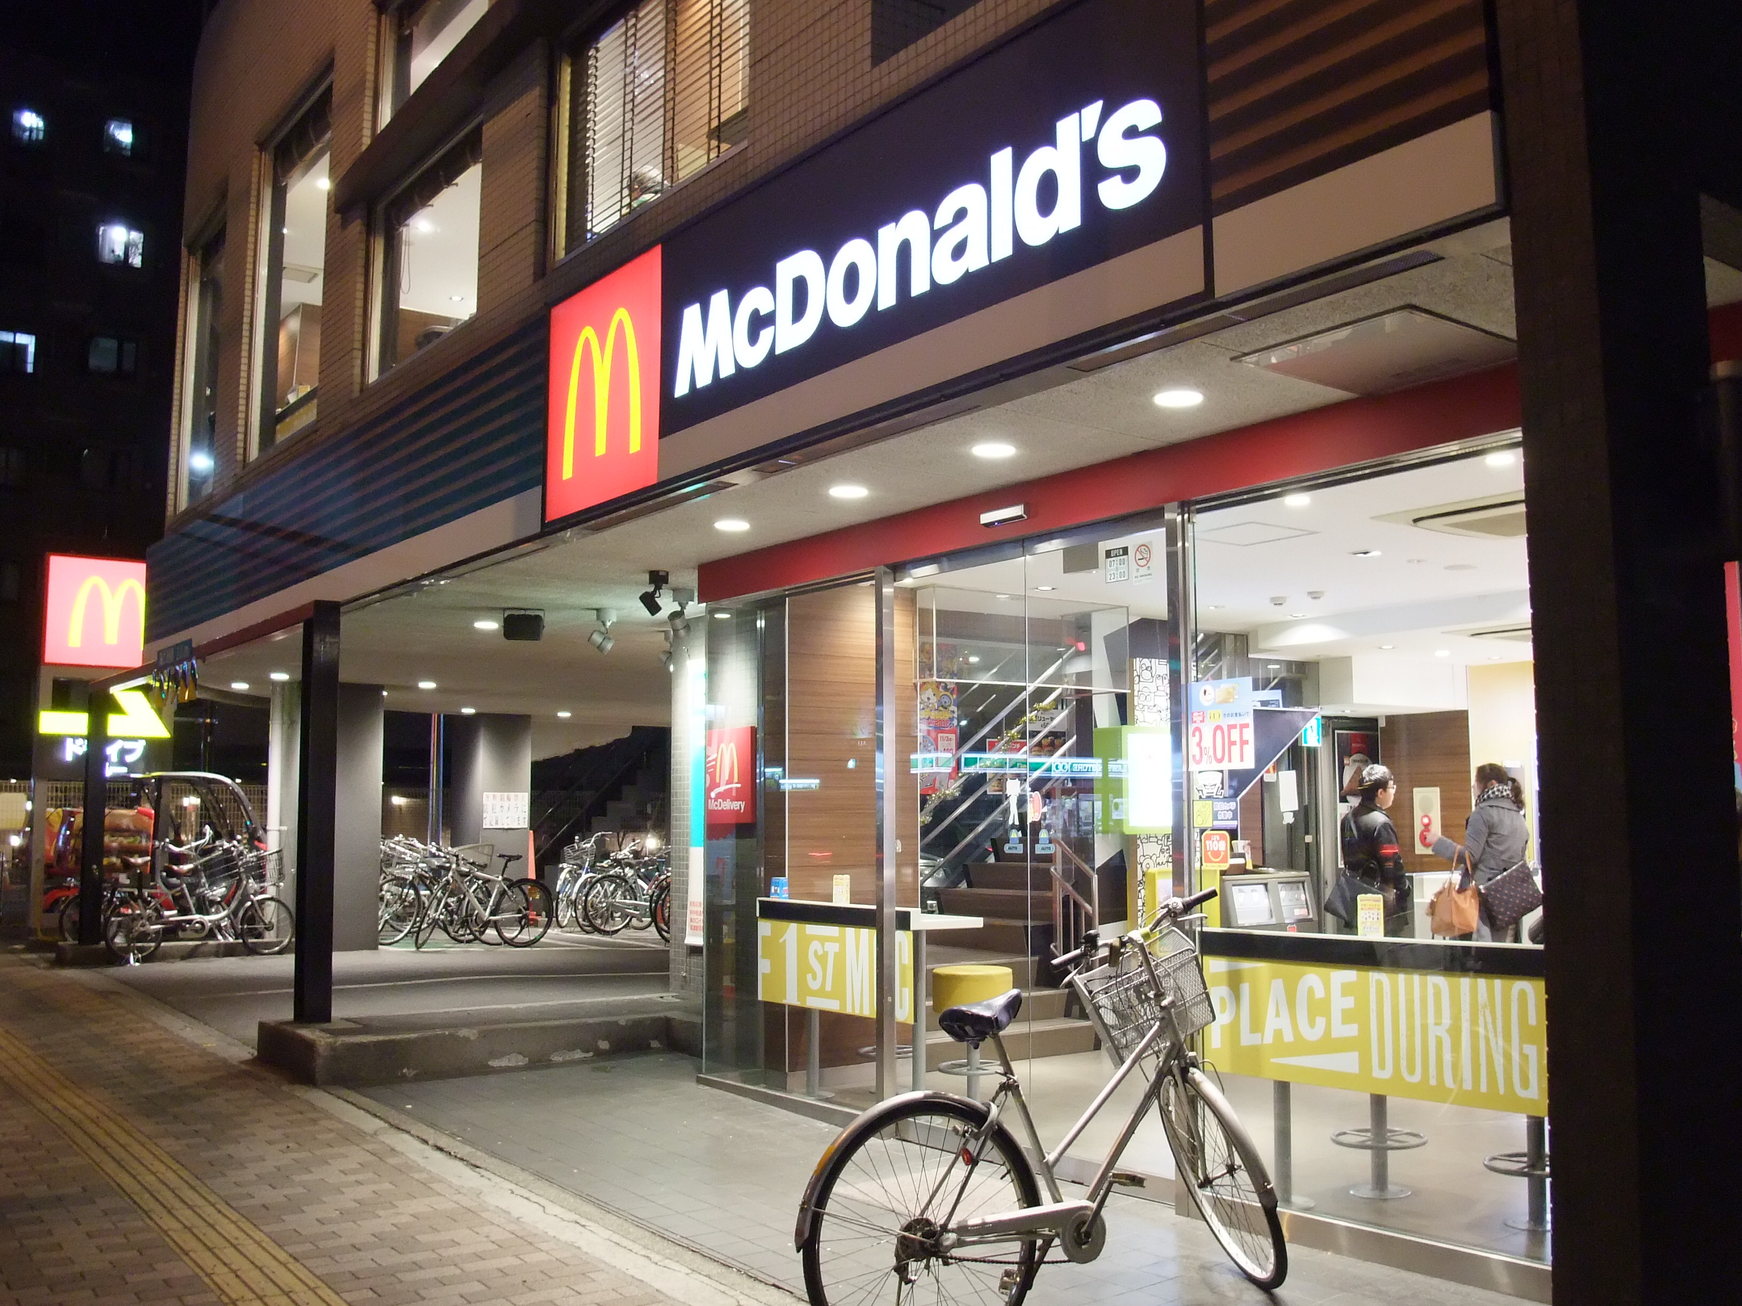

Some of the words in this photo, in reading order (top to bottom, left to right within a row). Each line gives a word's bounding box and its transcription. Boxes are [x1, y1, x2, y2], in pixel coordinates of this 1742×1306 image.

[675, 99, 1167, 398] McDonald's
[1110, 548, 1124, 557] OPEN
[65, 737, 147, 763] ドイブ
[708, 798, 745, 813] McDelivery
[1210, 970, 1358, 1049] PLACE
[1369, 972, 1539, 1100] DURING
